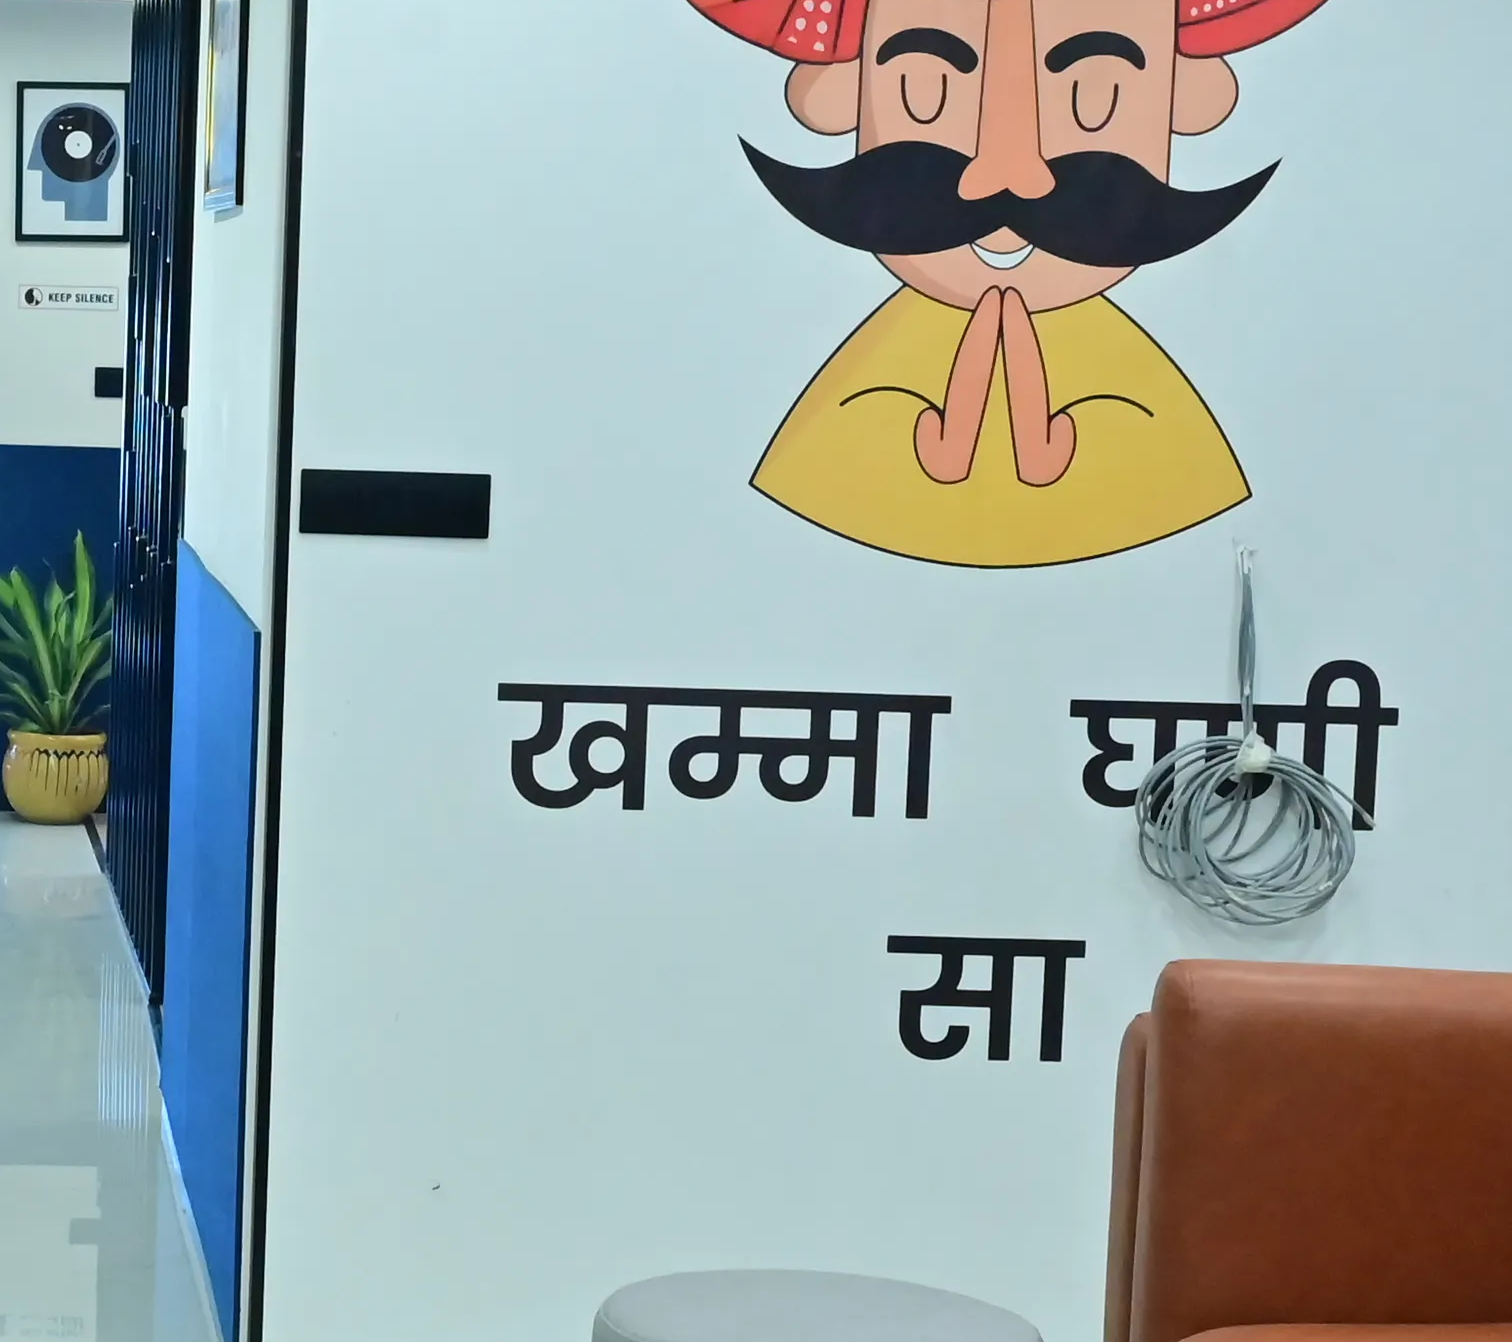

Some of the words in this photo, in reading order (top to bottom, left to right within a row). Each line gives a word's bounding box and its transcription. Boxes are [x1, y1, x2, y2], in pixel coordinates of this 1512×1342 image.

[48, 292, 72, 303] KEEP
[75, 293, 114, 304] SILENCE
[497, 683, 952, 819] खम्मा
[887, 935, 1086, 1062] सा
